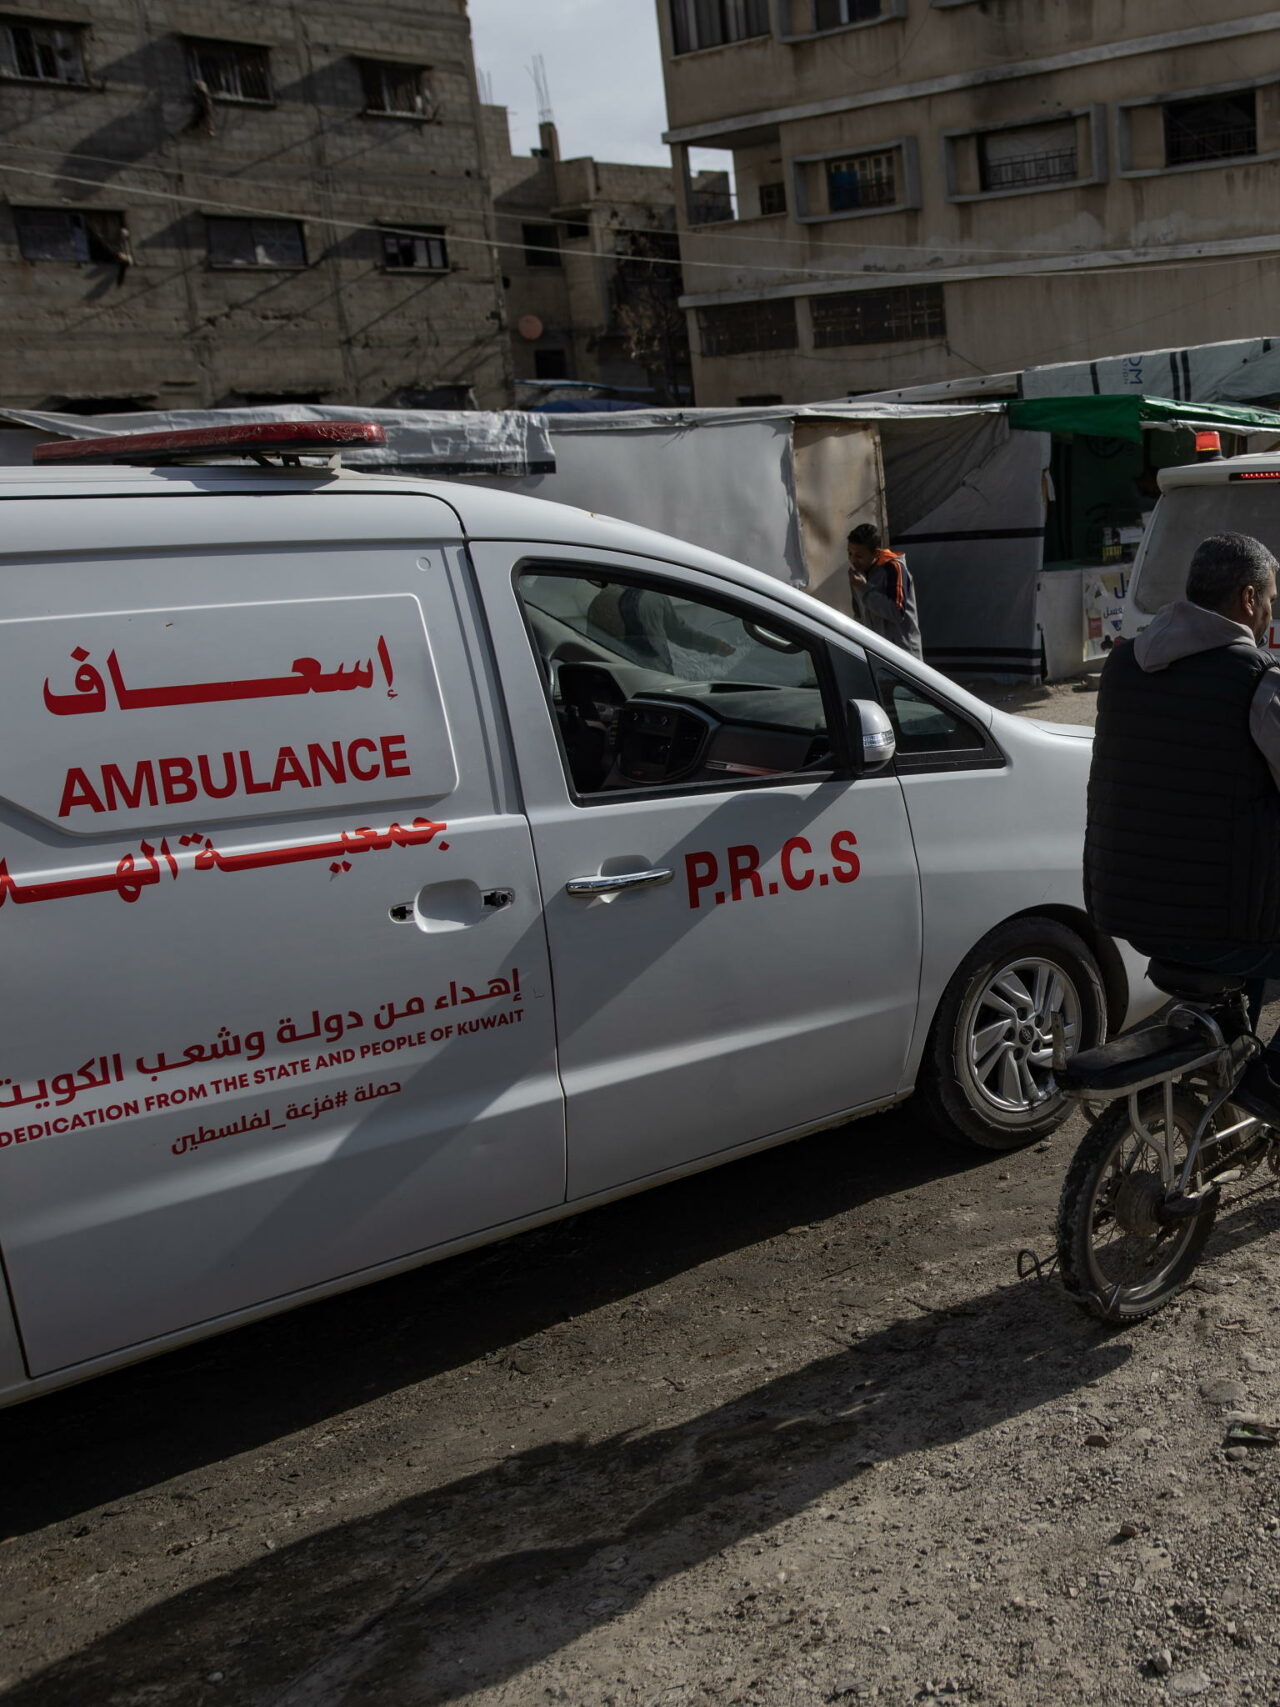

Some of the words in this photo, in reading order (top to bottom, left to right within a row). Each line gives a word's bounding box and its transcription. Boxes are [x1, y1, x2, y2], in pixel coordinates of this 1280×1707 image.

[43, 634, 398, 716] إسعاف
[58, 734, 411, 817] AMBULANCE
[179, 817, 450, 874] جمعية
[685, 830, 860, 909] P.R.C.S
[374, 996, 425, 1030] من
[434, 968, 522, 1010] إهداء
[136, 1026, 265, 1082] وشعب
[276, 1010, 364, 1044] دولة
[0, 1099, 139, 1147] DEDICATION
[145, 1084, 208, 1112] FROM
[210, 1073, 250, 1094] THE
[253, 1058, 312, 1085] STATE
[315, 1047, 356, 1070] AND
[360, 1031, 426, 1059] PEOPLE
[430, 1025, 453, 1042] OF
[457, 1009, 525, 1035] KUWAIT
[354, 1081, 401, 1103] حملة
